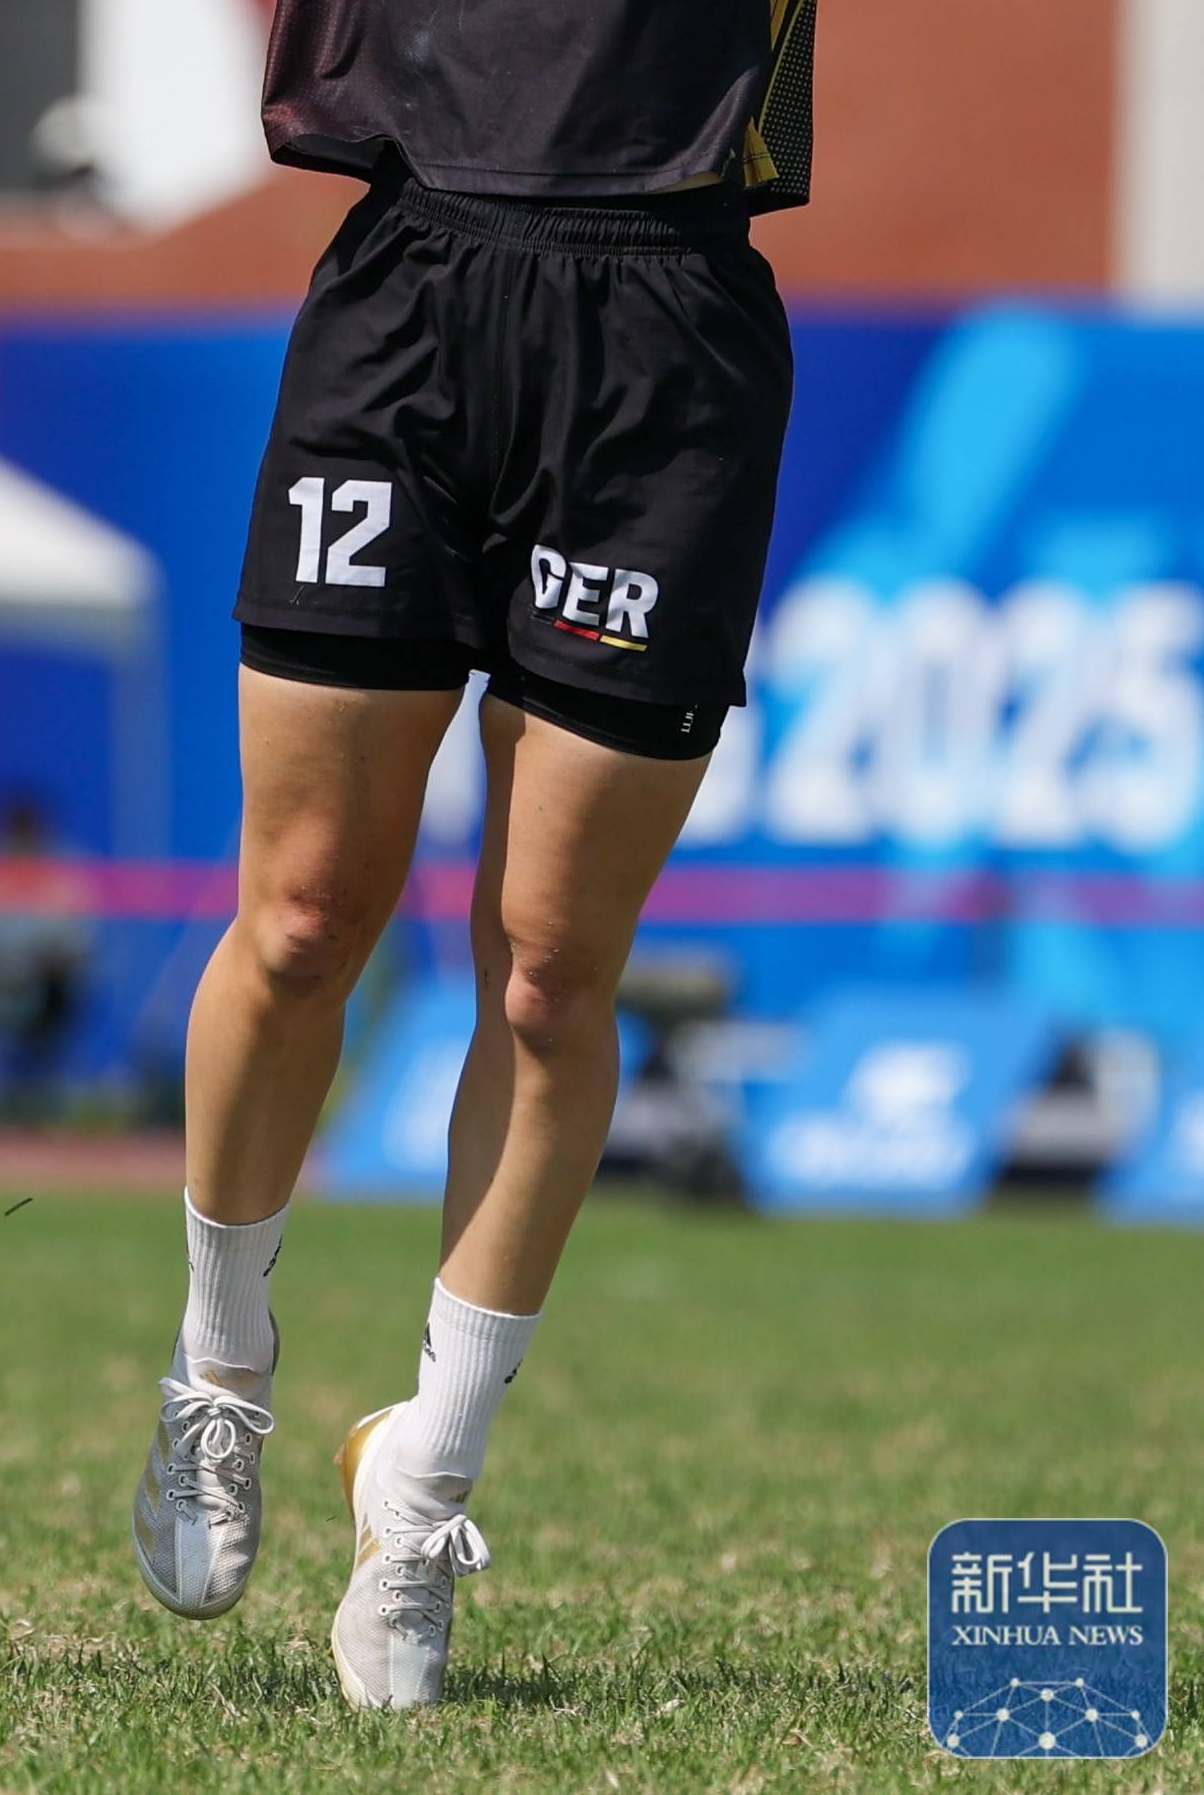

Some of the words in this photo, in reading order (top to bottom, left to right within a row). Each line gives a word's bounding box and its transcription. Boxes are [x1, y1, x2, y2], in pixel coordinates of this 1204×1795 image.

[288, 476, 392, 587] 12
[531, 544, 659, 639] GER
[764, 575, 1203, 850] 2025
